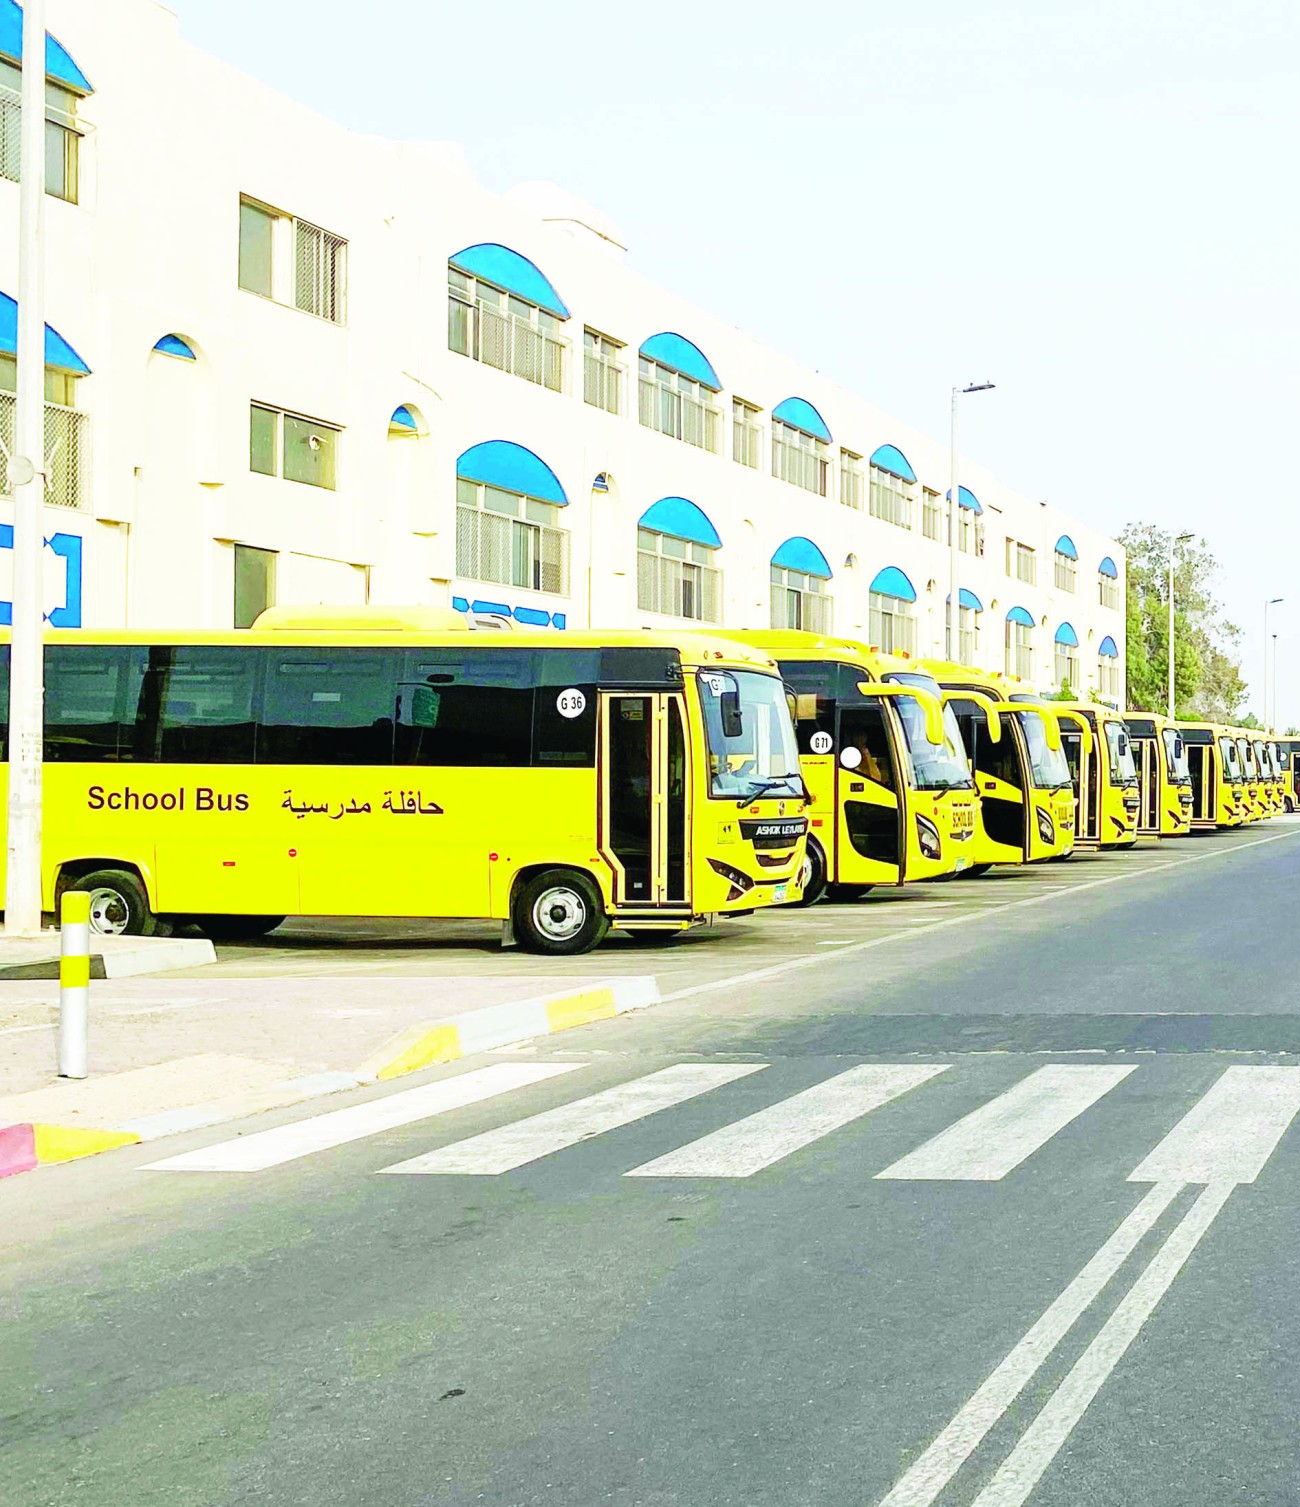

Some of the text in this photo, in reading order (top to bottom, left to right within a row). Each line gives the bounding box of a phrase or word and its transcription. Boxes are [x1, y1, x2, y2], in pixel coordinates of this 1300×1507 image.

[561, 696, 583, 710] G 36
[815, 737, 828, 748] G 71
[88, 785, 249, 811] School Bus
[281, 789, 444, 820] حافلة مدرسية
[755, 824, 781, 836] ASHOK
